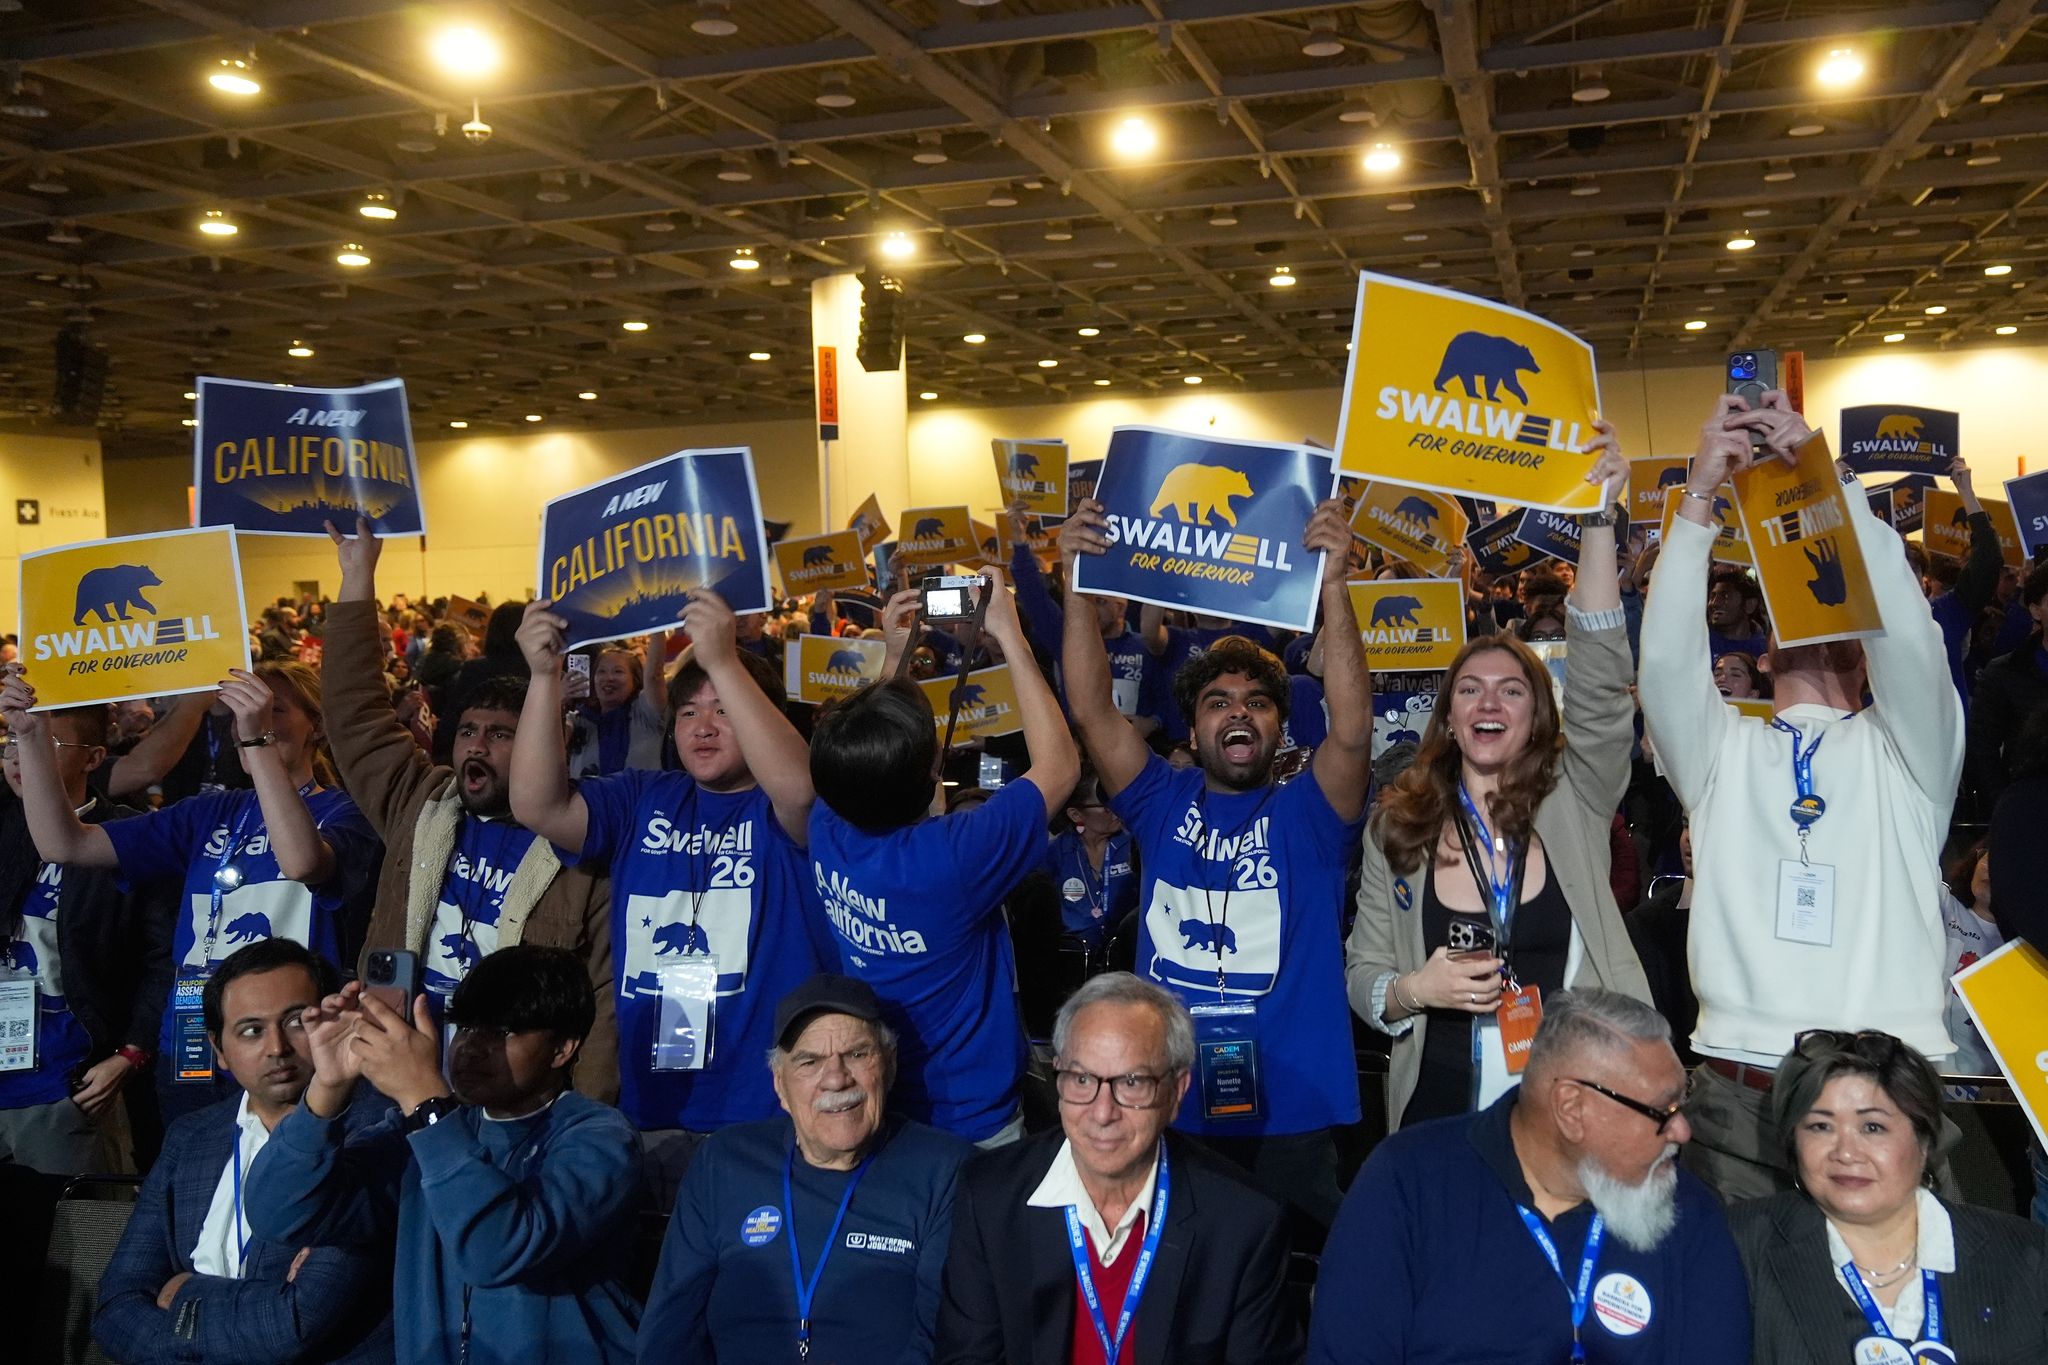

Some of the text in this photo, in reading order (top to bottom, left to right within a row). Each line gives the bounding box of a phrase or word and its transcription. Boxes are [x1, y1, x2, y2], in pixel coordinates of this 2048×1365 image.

[824, 352, 833, 404] REGION
[286, 408, 368, 427] A NEW
[1376, 386, 1584, 454] SWALWELL
[214, 436, 411, 488] CALIFORNIA
[1408, 433, 1546, 470] FOR GOVERNOR
[1852, 439, 1948, 457] SWALWELL
[601, 479, 669, 518] A NEW
[1368, 506, 1448, 554] SWALWELL
[1537, 511, 1582, 540] SWAL
[551, 512, 746, 603] CALIFORNIA
[901, 537, 968, 553] SWALWELL
[1104, 514, 1292, 572] SWALWELL
[789, 561, 857, 581] SWALWELL
[1130, 553, 1255, 586] FOR GOVERNOR
[35, 615, 219, 661] SWALWELL
[1362, 627, 1452, 644] WALWELL
[1384, 645, 1434, 655] GOVERNOR
[68, 649, 188, 676] FOR GOVERNOR
[815, 861, 885, 921] A New
[824, 899, 928, 954] alifornia
[175, 996, 203, 1006] DEMOCRA
[176, 986, 204, 997] ASSEMB
[1217, 1078, 1241, 1086] Nanette
[1084, 1274, 1098, 1310] NEWSOM
